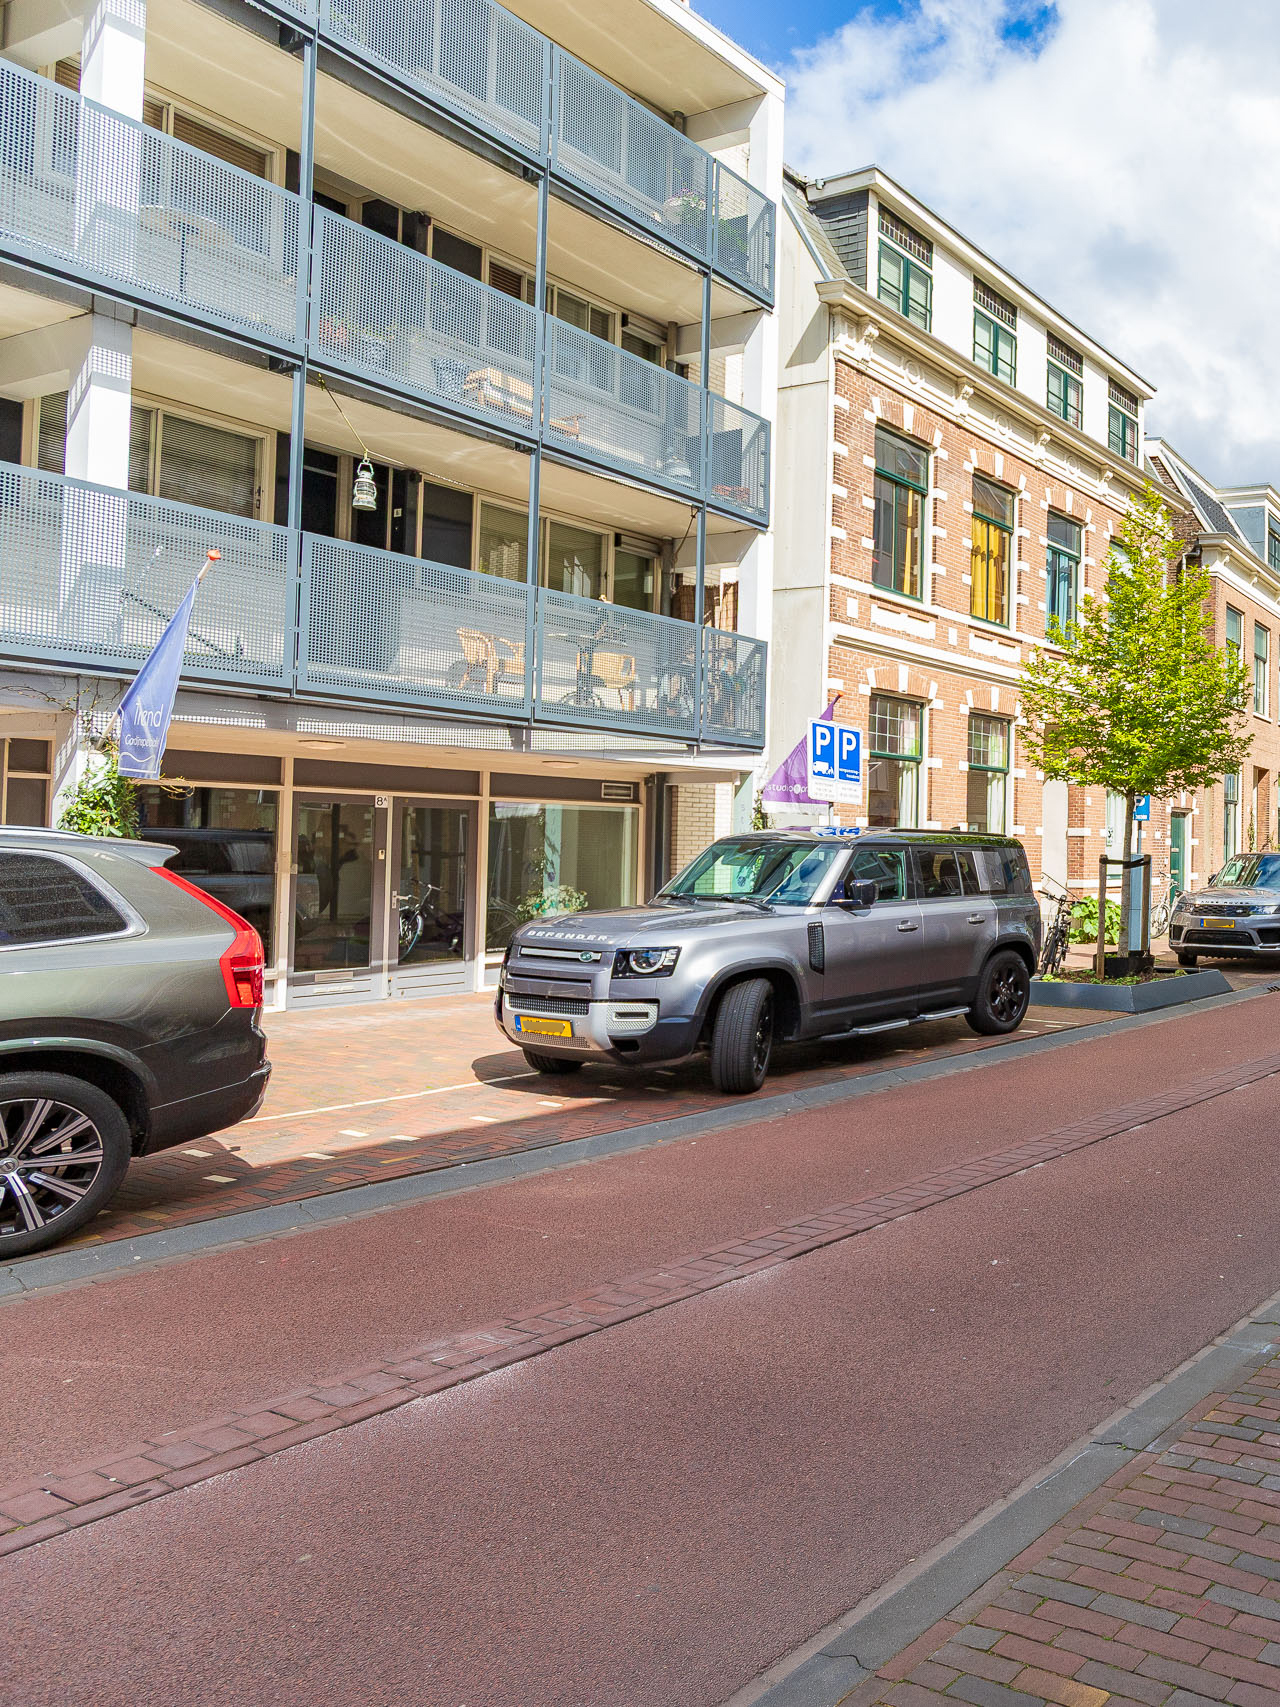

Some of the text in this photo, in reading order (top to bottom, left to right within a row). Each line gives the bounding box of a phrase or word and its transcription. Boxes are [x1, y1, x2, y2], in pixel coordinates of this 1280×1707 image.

[816, 726, 831, 755] P
[842, 732, 857, 760] P
[527, 930, 608, 941] DEFENDER
